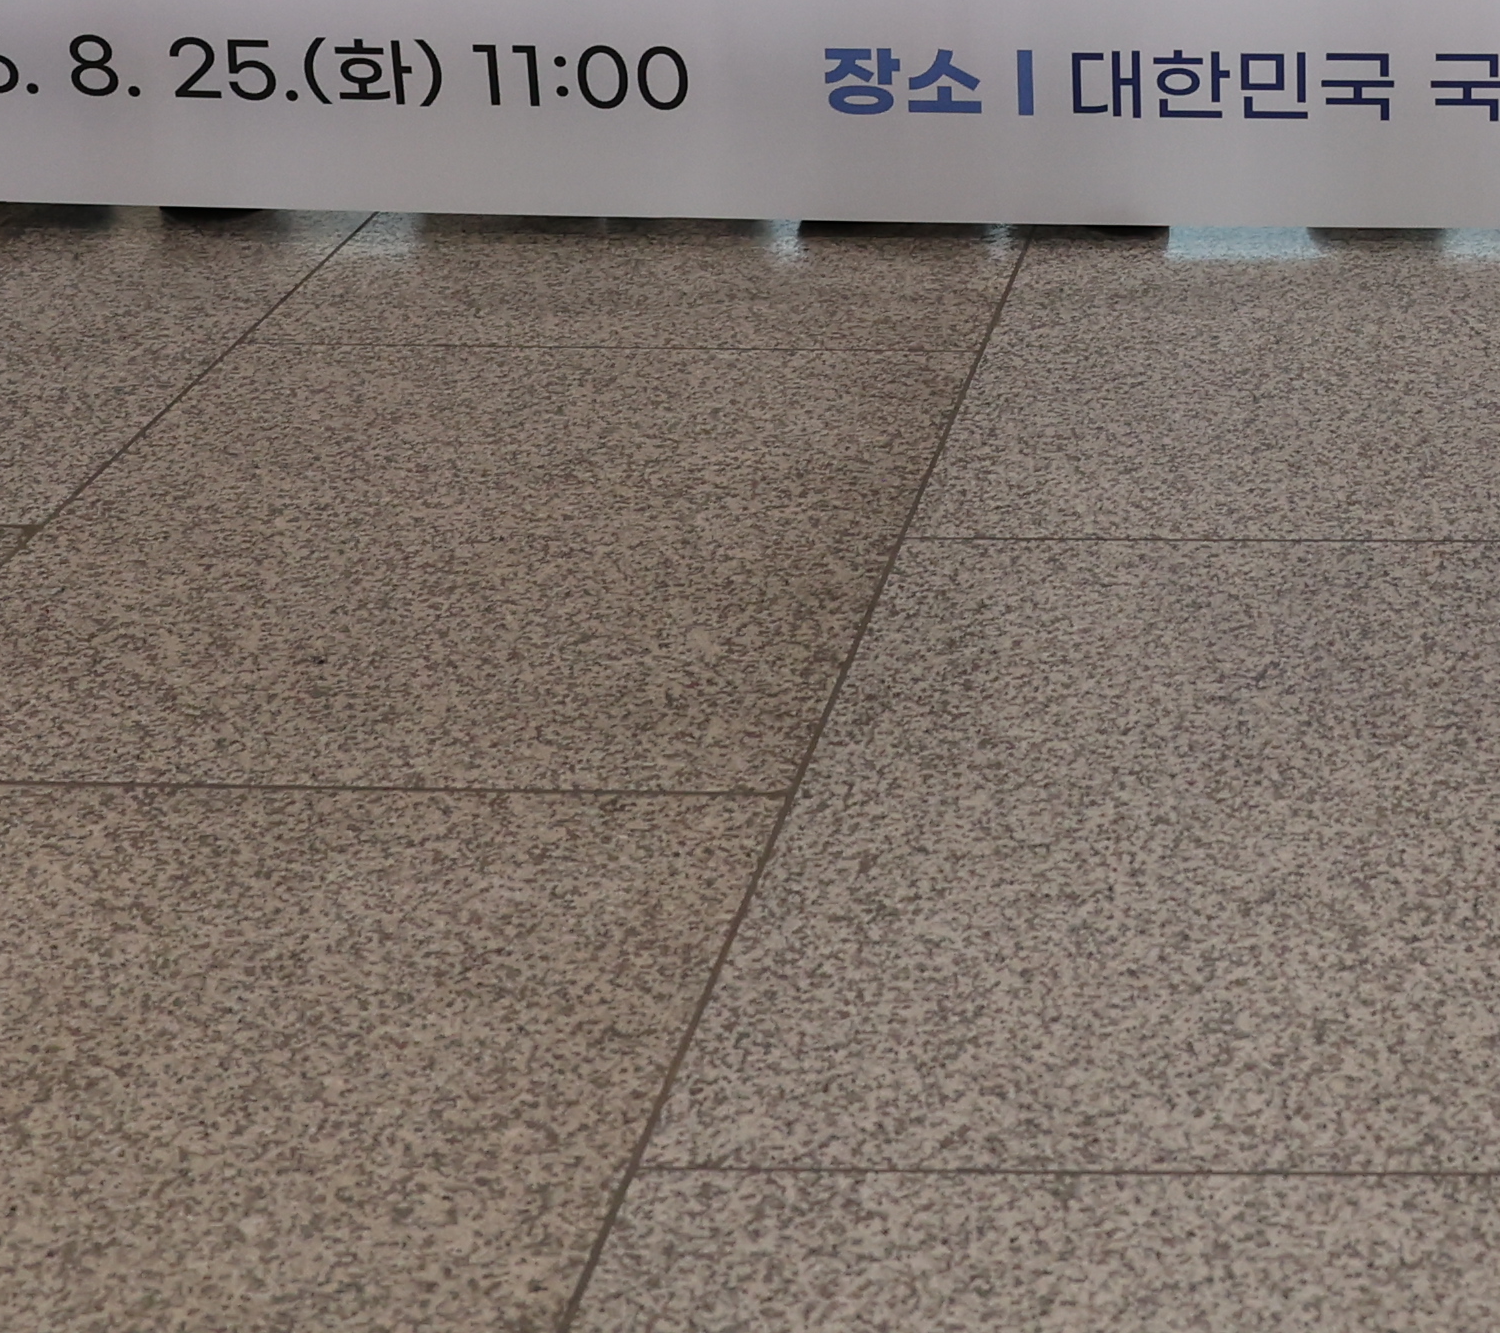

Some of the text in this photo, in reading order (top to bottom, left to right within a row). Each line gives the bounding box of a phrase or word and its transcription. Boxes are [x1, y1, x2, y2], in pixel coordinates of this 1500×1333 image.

[69, 34, 141, 98] 8.
[169, 36, 443, 107] 25.(화)
[472, 44, 689, 111] 11:00
[824, 47, 983, 116] 장소
[1071, 49, 1395, 121] 대한민국
